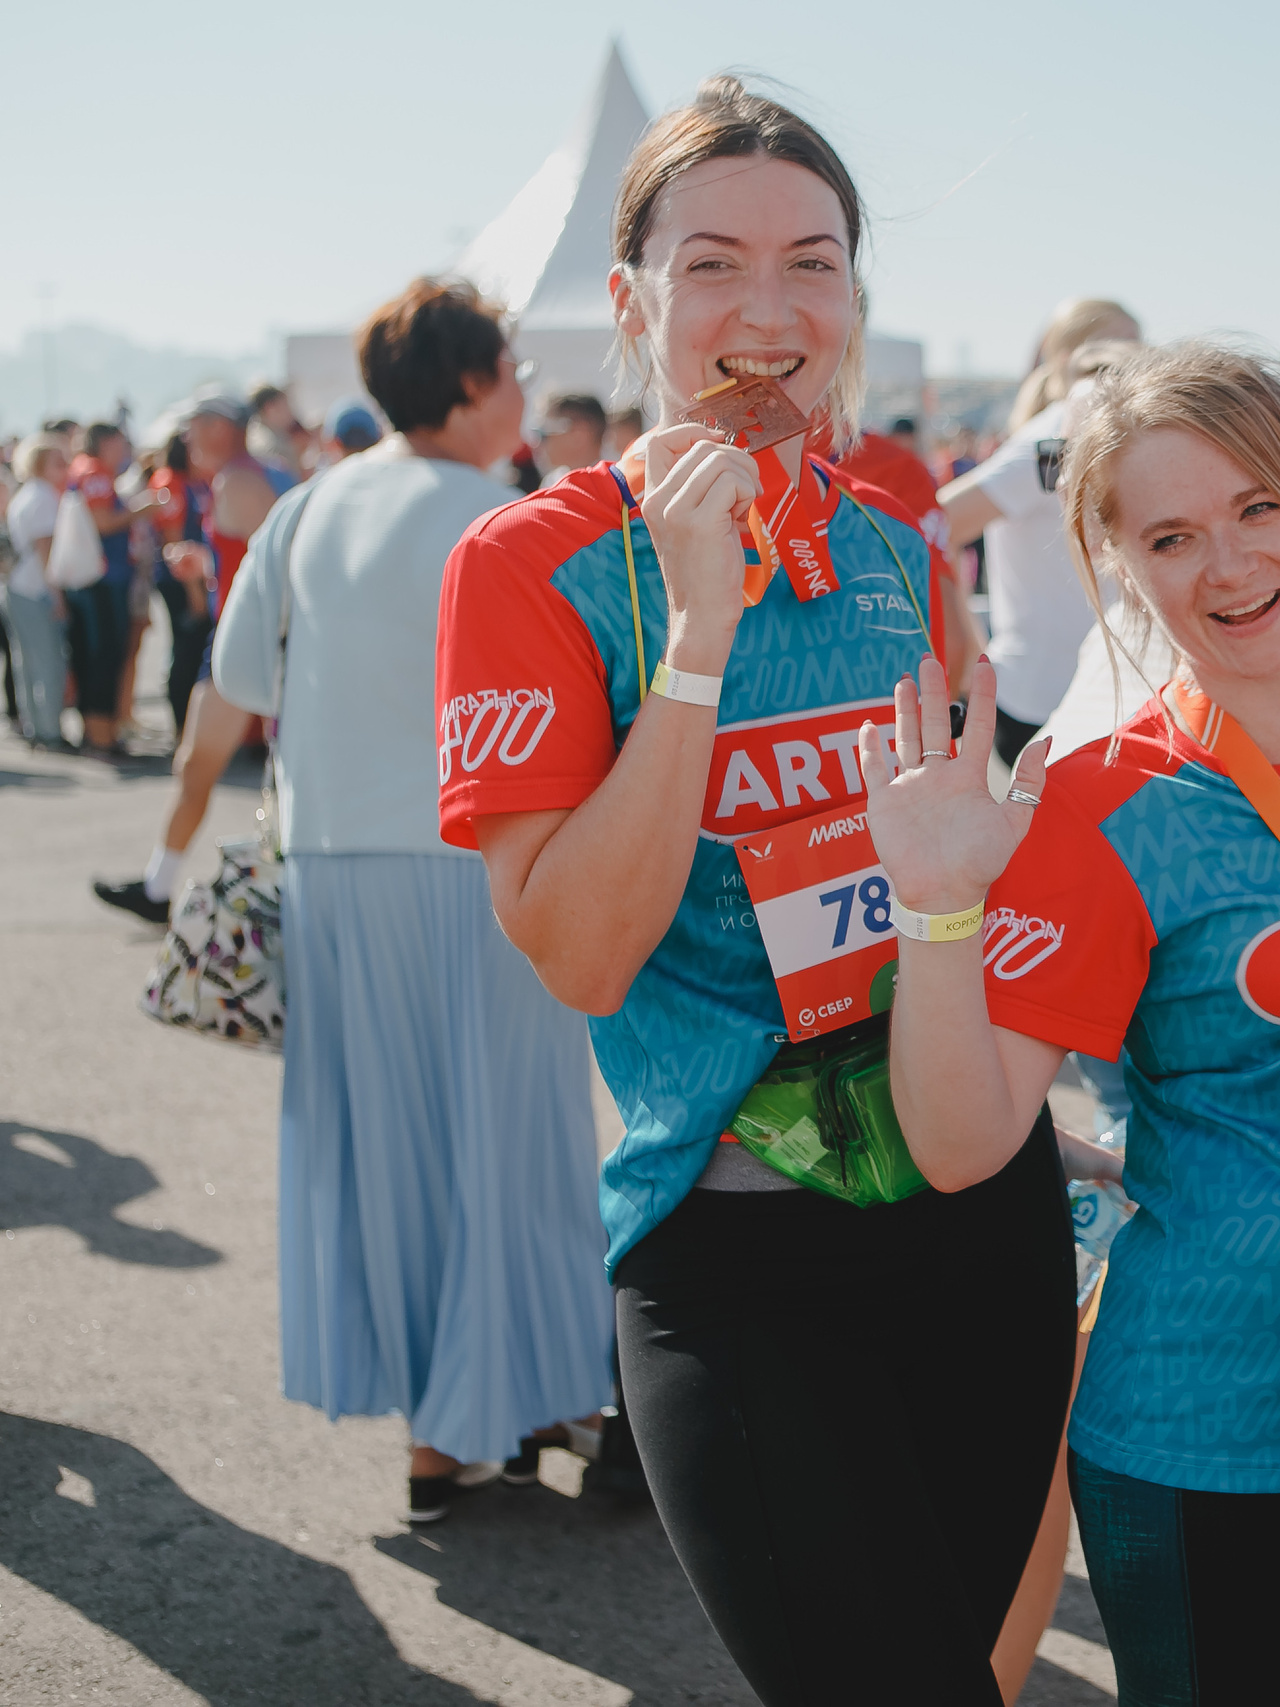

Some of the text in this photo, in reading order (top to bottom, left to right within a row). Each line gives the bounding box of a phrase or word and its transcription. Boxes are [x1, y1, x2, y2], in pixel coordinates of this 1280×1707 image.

[715, 723, 900, 818] ART
[819, 876, 894, 949] 78
[818, 996, 853, 1018] СБЕР
